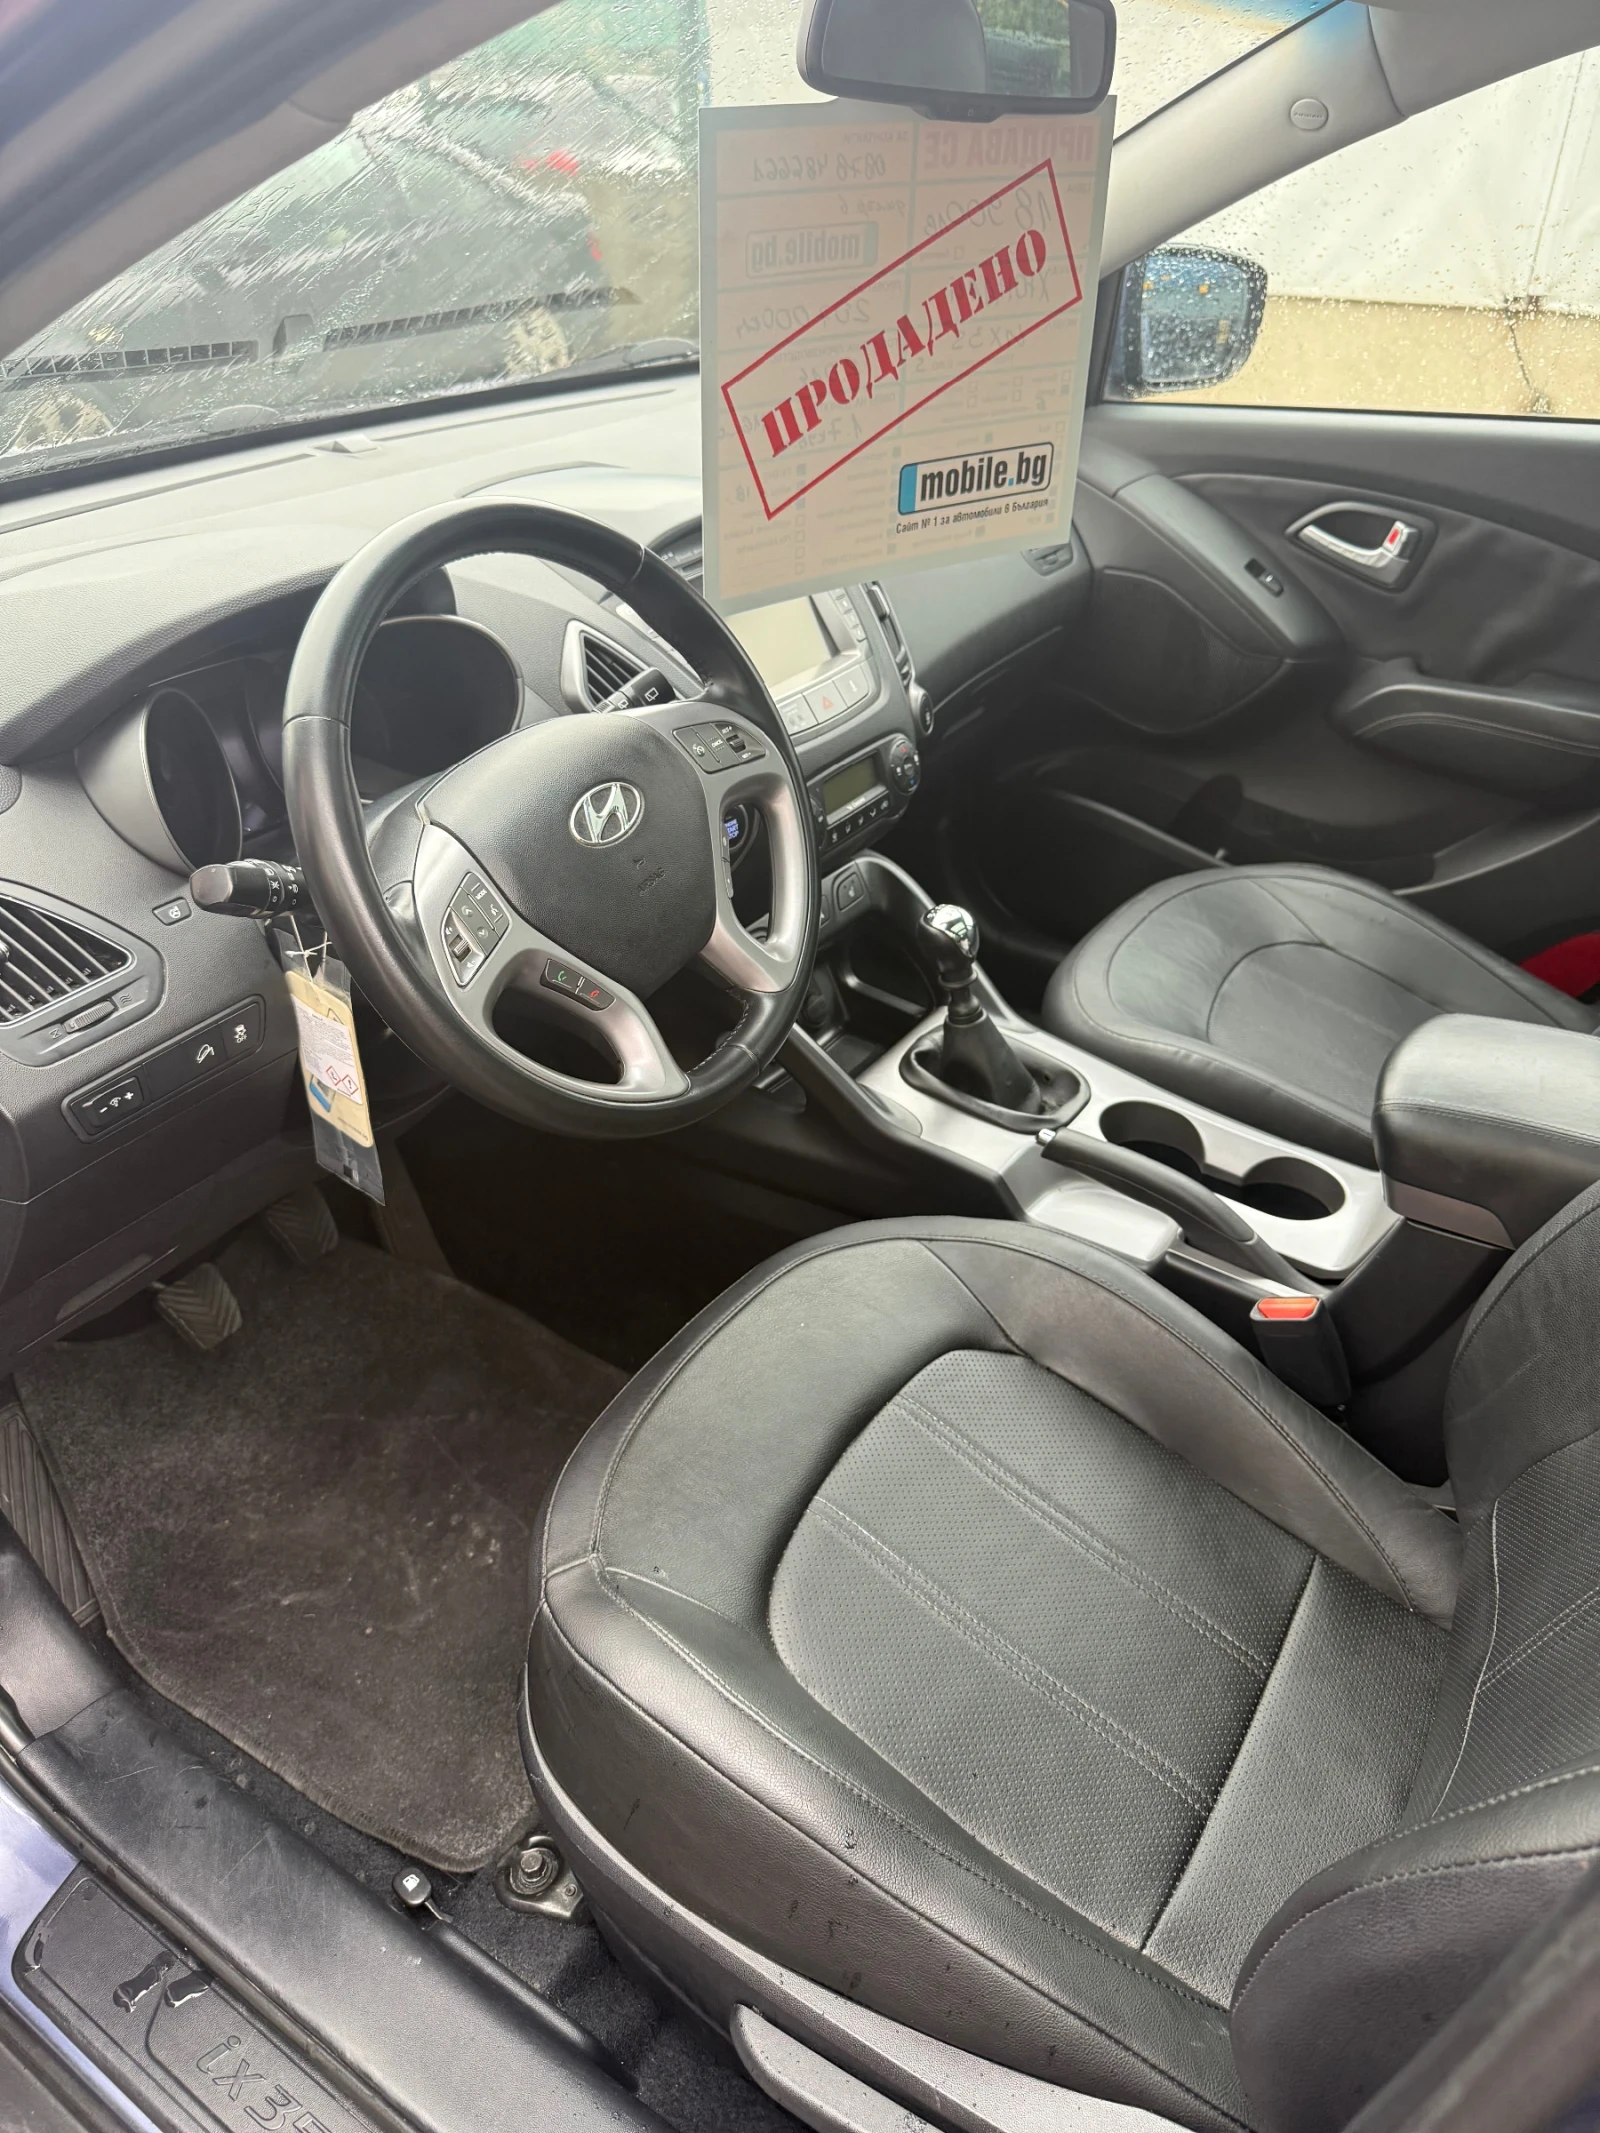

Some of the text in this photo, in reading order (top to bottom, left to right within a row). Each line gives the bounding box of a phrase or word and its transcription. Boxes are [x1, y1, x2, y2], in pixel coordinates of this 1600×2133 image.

[761, 229, 1047, 458] ПРОДАДЕНО
[920, 451, 1047, 502] mobile.bg
[896, 521, 919, 534] Сайт
[933, 517, 938, 527] 1
[940, 516, 950, 526] за
[952, 506, 1002, 524] автомобили
[1012, 498, 1049, 512] България
